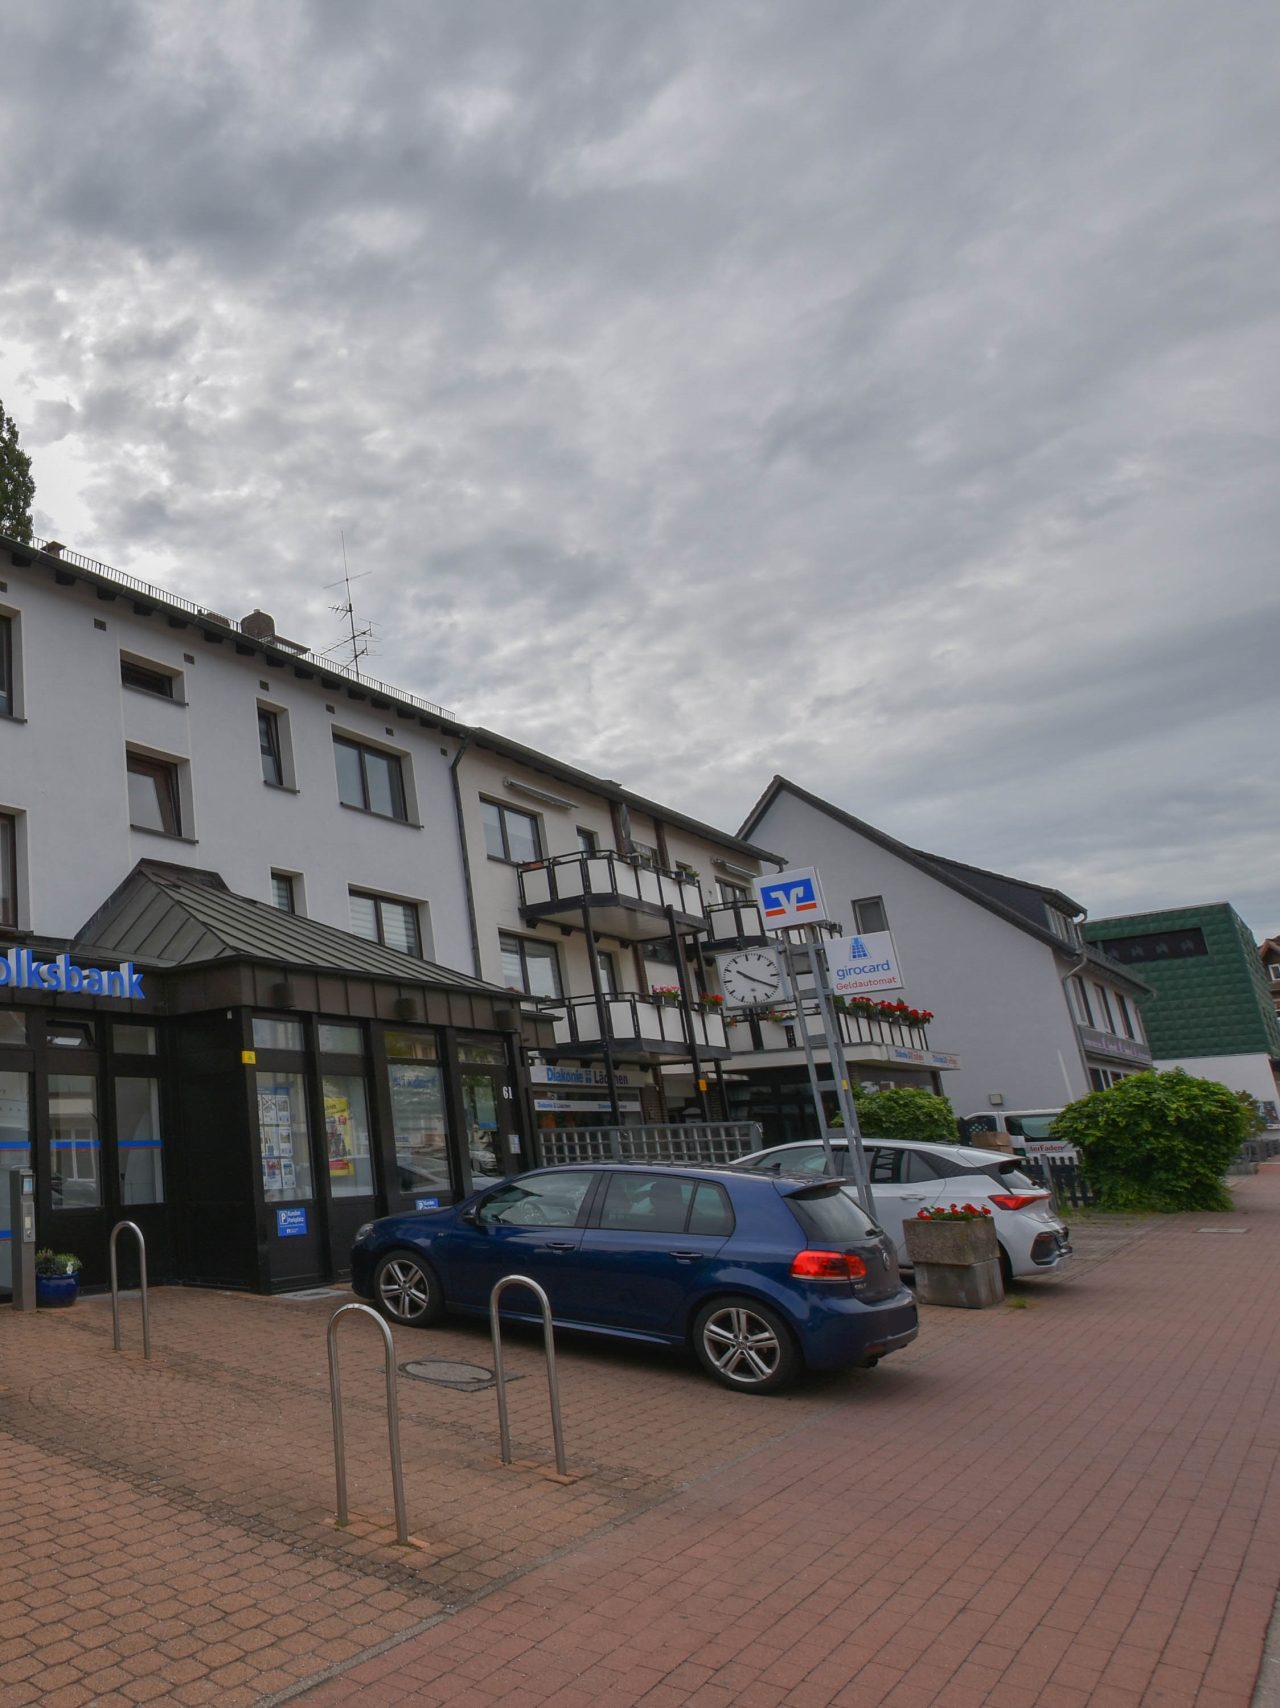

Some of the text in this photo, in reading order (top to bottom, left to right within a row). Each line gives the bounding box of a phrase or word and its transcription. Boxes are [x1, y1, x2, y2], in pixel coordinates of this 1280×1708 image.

[836, 960, 891, 980] girocard
[836, 976, 897, 991] Geldautomat
[546, 1067, 629, 1085] Diakonie Lähen
[502, 1086, 513, 1099] 61
